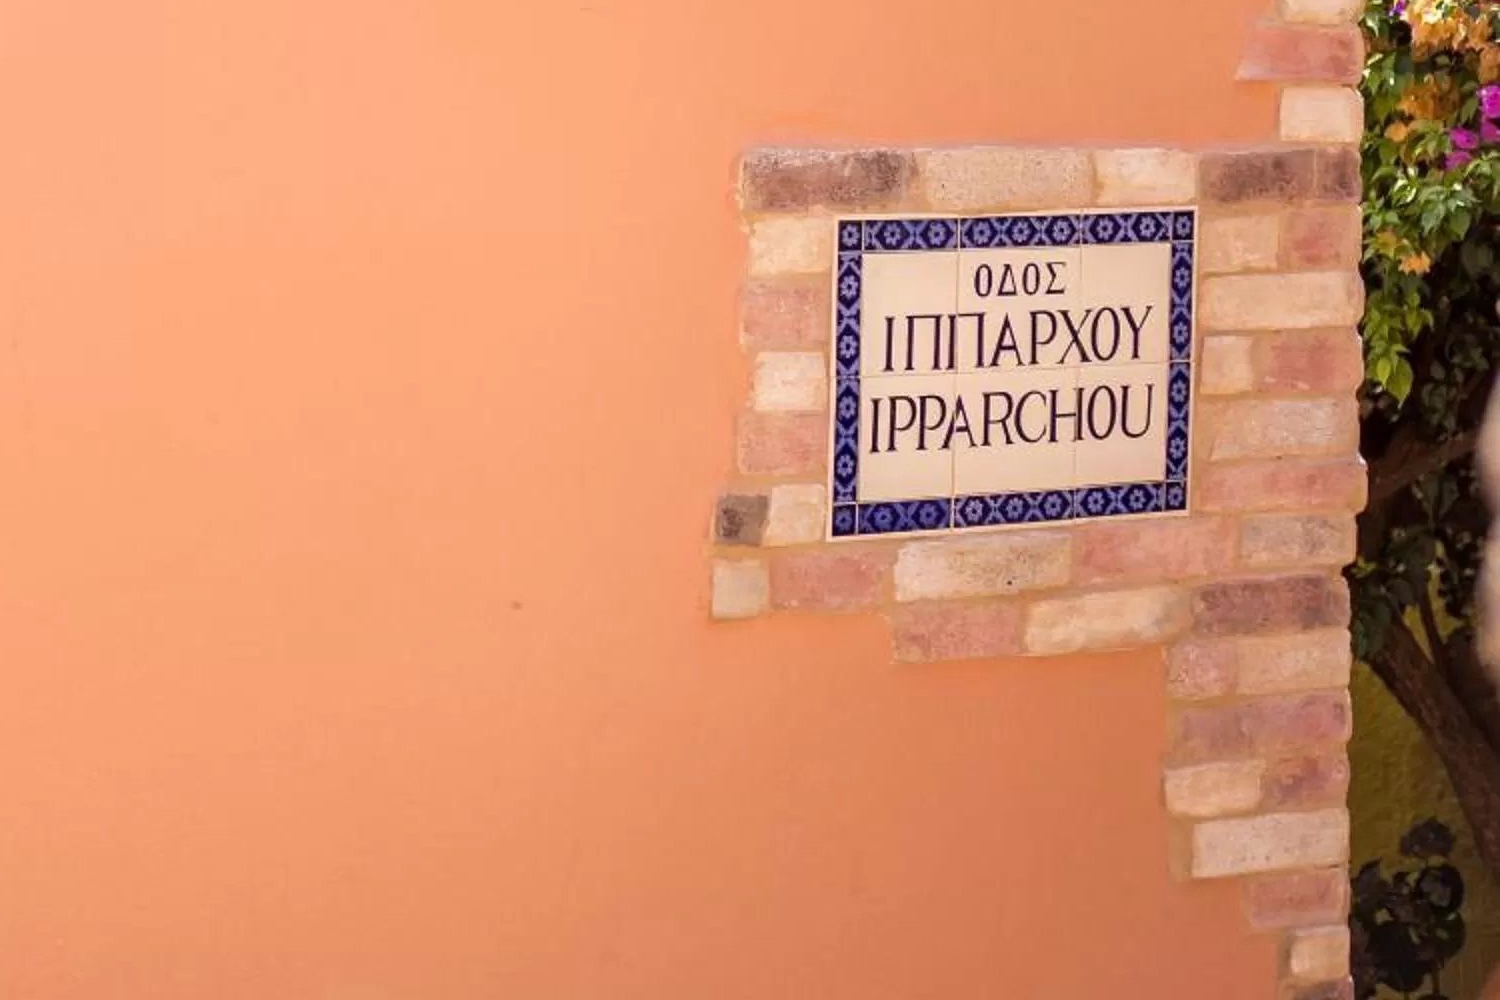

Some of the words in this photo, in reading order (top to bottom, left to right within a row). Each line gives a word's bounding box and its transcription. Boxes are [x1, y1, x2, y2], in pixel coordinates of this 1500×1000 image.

[973, 261, 1066, 298] ΟΔΟΣ
[882, 304, 1154, 373] ΙΠΠΑΡΧΟΥ
[868, 383, 1155, 454] IPPARCHOU
